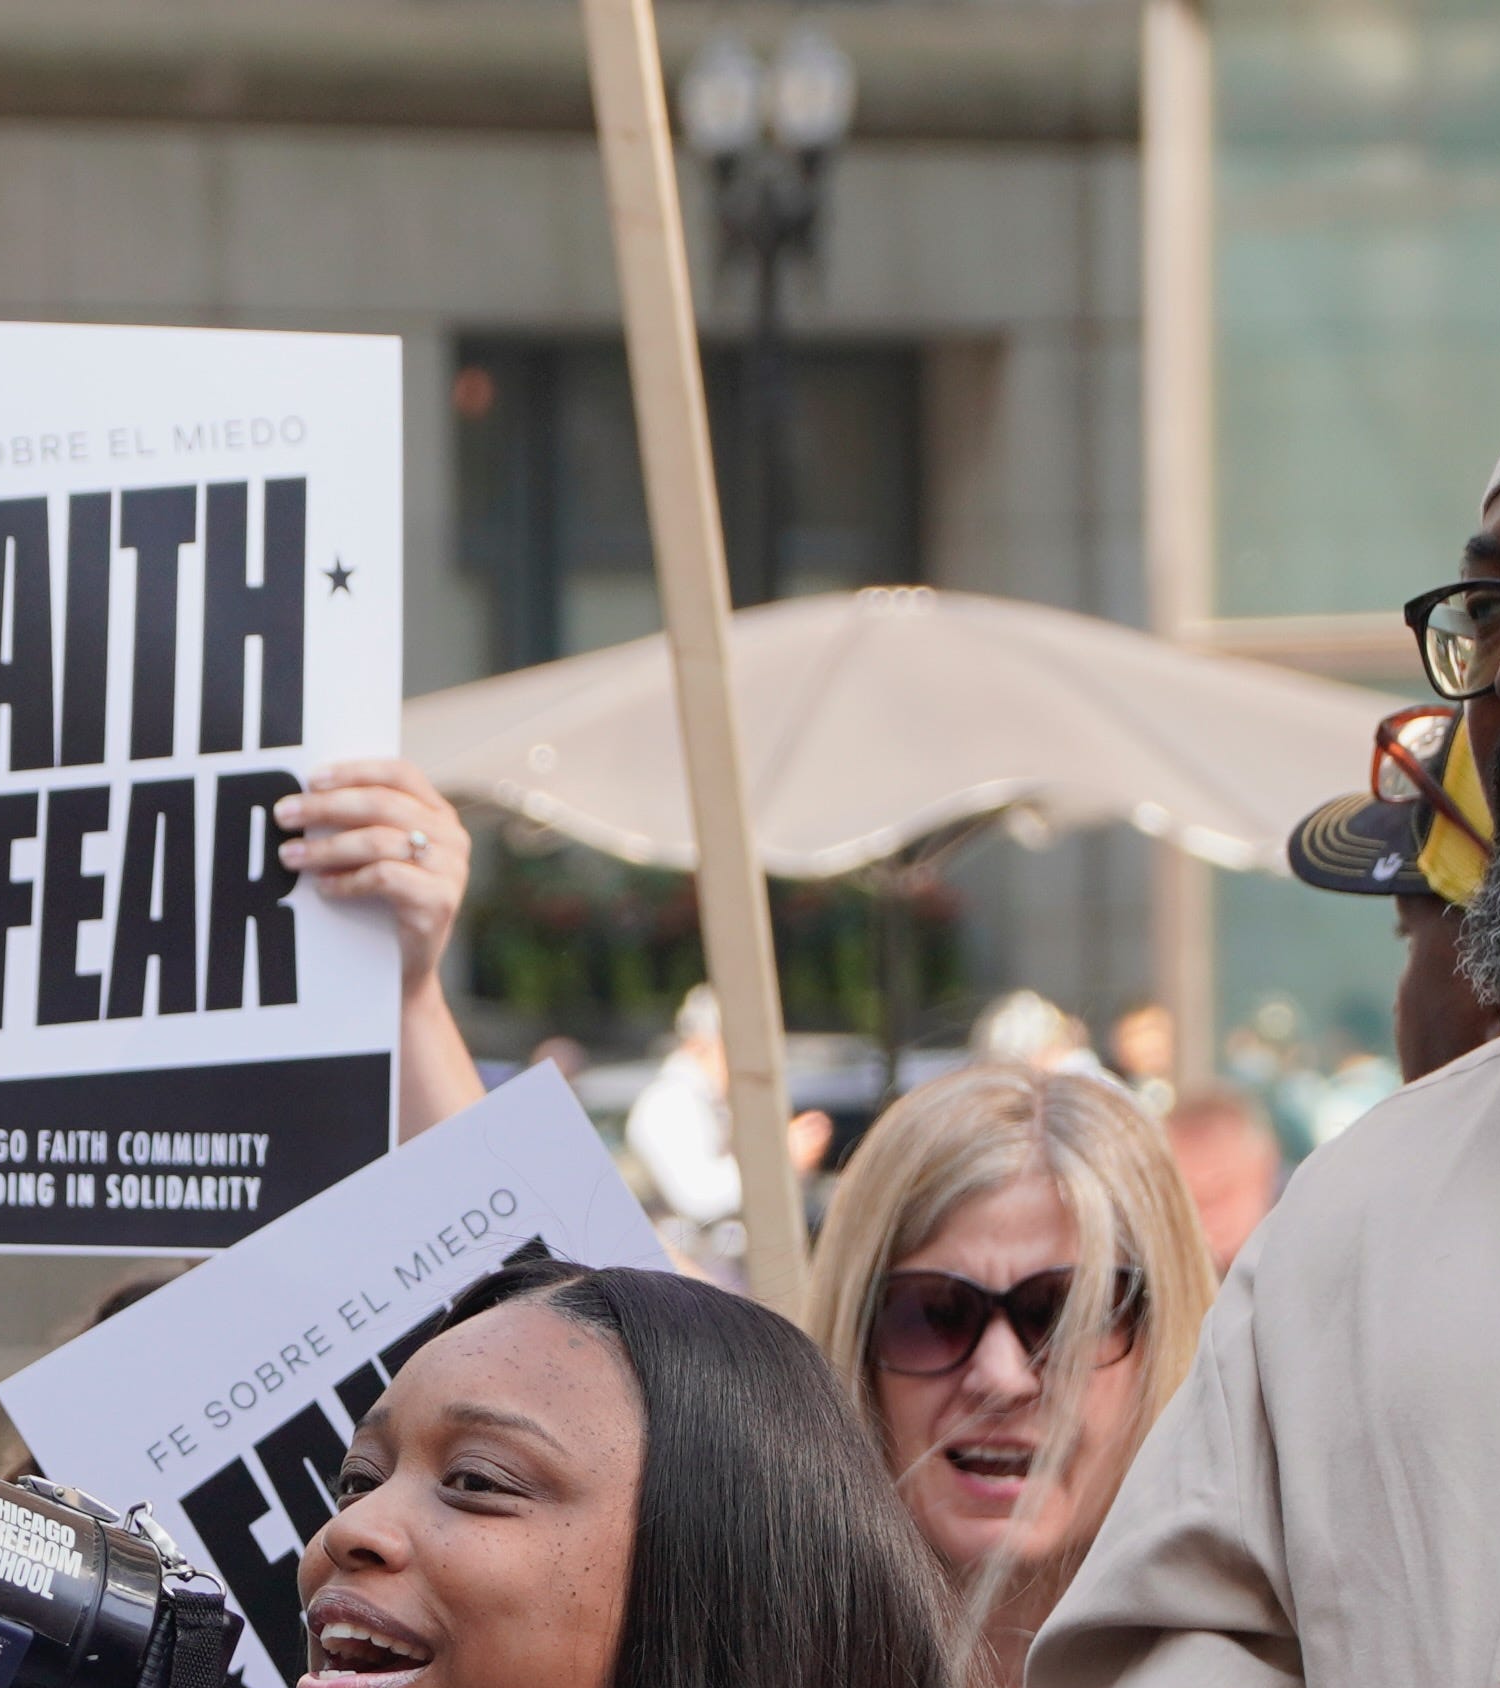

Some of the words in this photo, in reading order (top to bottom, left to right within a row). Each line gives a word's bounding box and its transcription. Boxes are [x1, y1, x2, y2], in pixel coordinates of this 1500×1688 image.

[36, 1129, 108, 1165] FAITH
[116, 1129, 270, 1168] COMMUNITY
[65, 1172, 98, 1207] IN
[104, 1173, 264, 1212] SOLIDARITY
[147, 1426, 196, 1474] FE
[202, 1327, 334, 1430] SOBRE
[336, 1291, 390, 1334] EL
[393, 1185, 520, 1287] MIEDO
